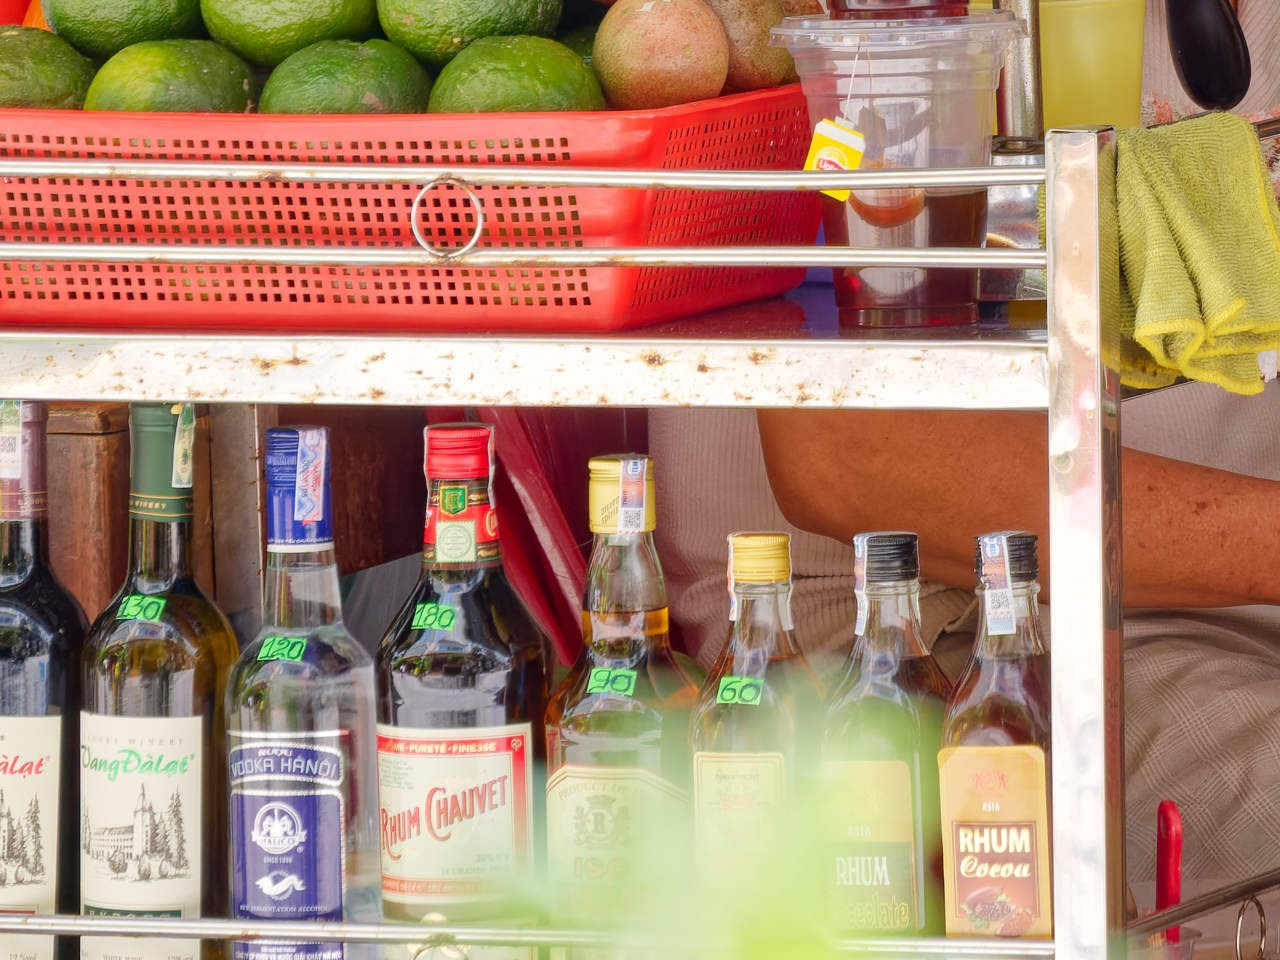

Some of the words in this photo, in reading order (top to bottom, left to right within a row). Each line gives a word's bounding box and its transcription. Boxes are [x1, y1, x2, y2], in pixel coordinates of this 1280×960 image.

[257, 638, 306, 660] 120
[588, 670, 633, 694] 90
[719, 681, 762, 703] 60
[231, 758, 274, 777] VODKA
[381, 807, 421, 861] RHUM
[425, 774, 508, 842] CHAUVET
[960, 827, 1031, 854] RHUM
[836, 855, 891, 887] RHUM
[960, 855, 1032, 878] Cocoa
